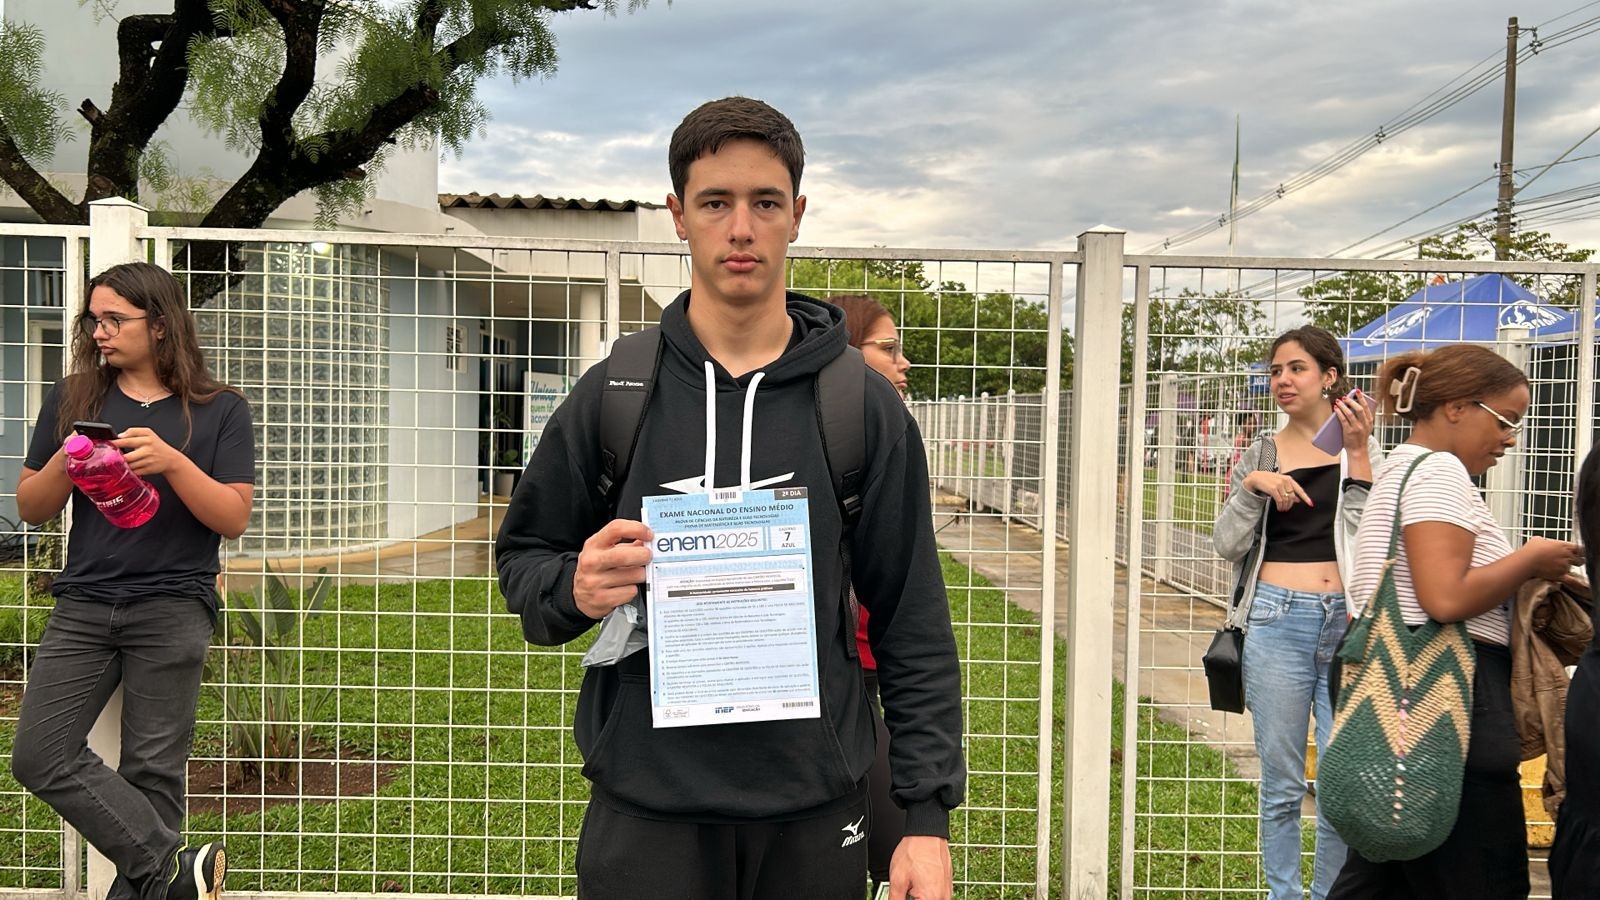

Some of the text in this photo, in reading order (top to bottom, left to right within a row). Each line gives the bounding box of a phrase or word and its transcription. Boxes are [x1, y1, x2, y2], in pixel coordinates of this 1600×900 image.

[660, 511, 685, 519] EXAME
[687, 509, 724, 517] NACIONAL
[740, 505, 767, 513] ENSINO
[769, 503, 794, 511] MÉDIO
[657, 532, 758, 552] enem2025
[784, 532, 791, 541] 7
